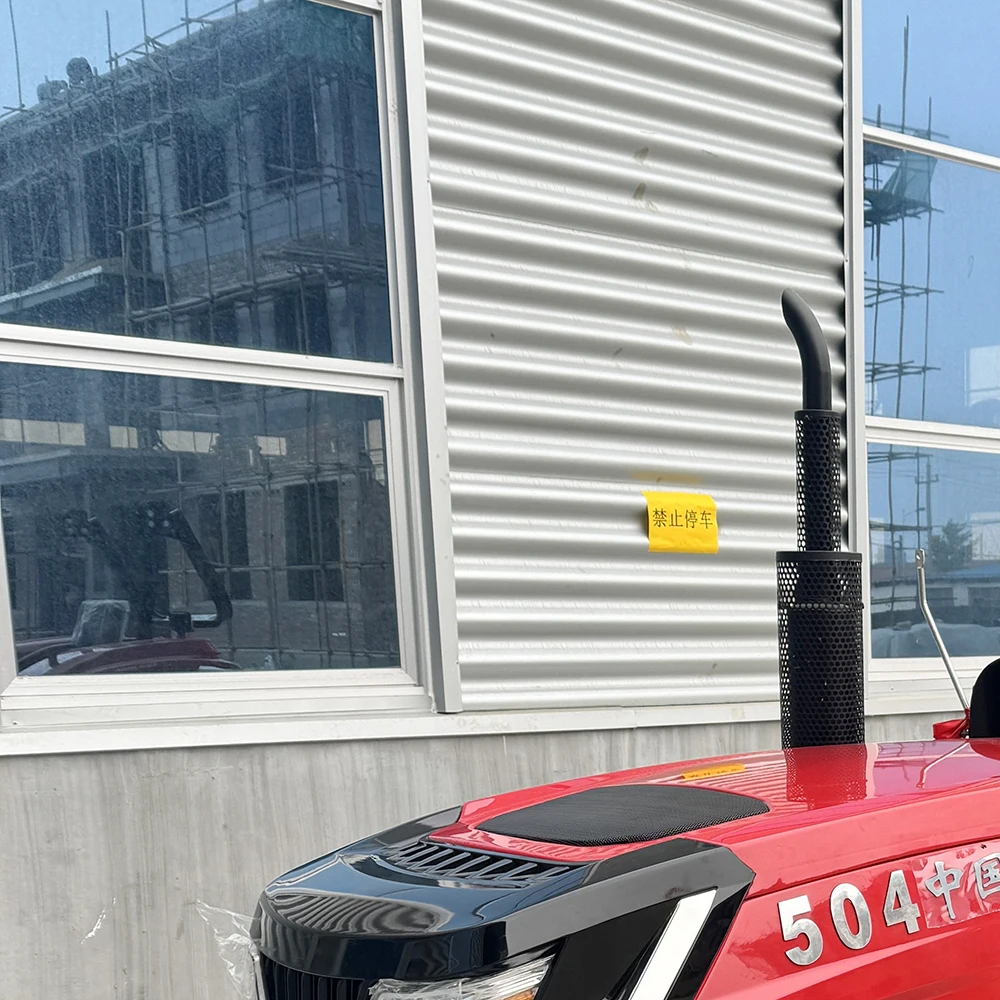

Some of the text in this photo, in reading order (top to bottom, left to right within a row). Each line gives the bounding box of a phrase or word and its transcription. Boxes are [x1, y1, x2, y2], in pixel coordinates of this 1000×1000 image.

[652, 507, 713, 529] 禁止停车
[778, 869, 921, 966] 504
